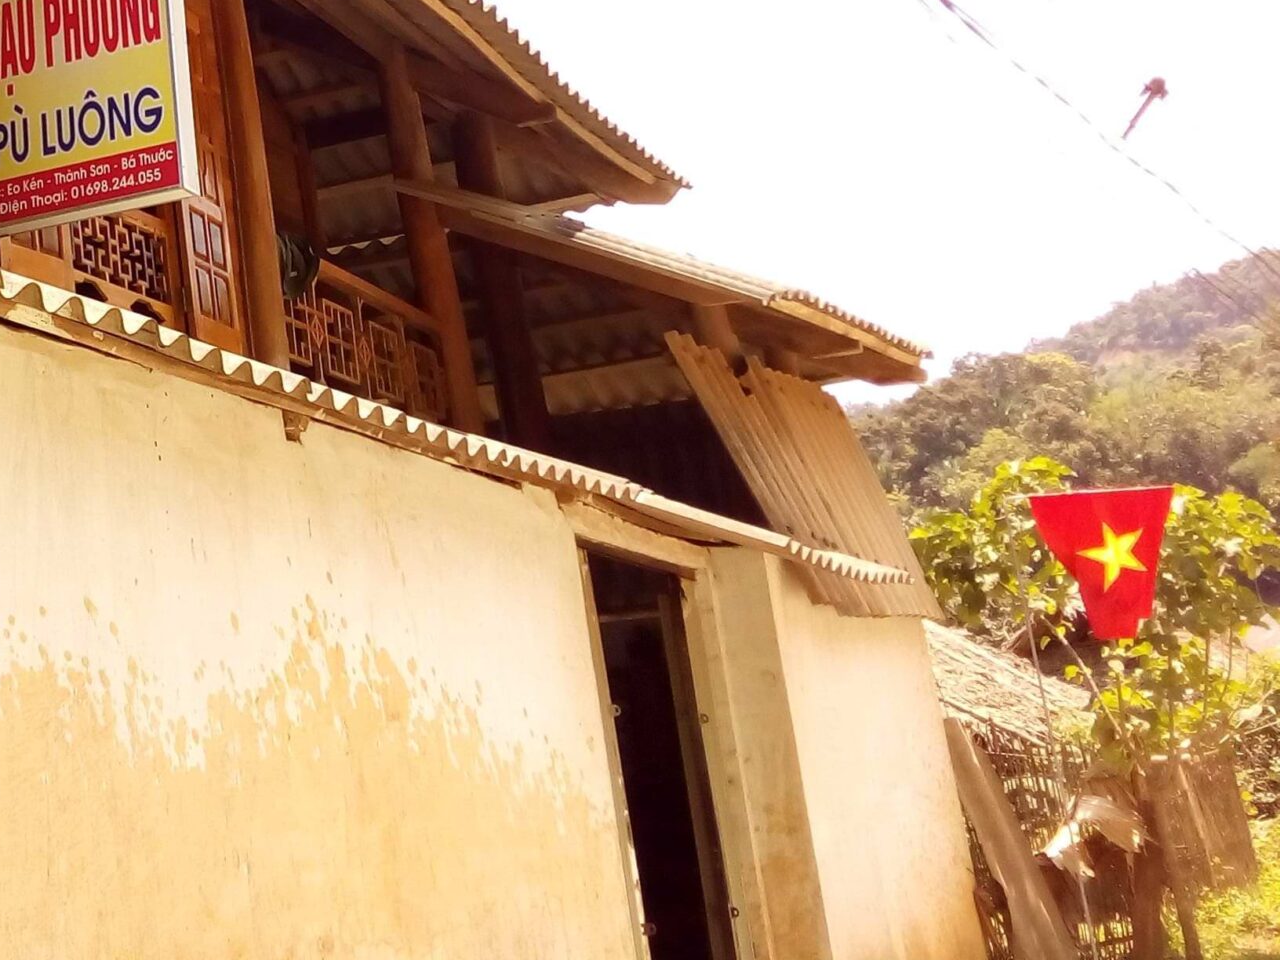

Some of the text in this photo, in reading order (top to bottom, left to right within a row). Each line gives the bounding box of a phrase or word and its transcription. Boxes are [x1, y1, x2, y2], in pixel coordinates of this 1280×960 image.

[41, 87, 163, 156] LUÔNG
[0, 168, 162, 215] Điện Thoại: 01698.244.055
[7, 183, 22, 196] Eo
[23, 177, 44, 192] Kén
[54, 167, 88, 186] Thành
[89, 162, 111, 177] Sơn
[121, 155, 136, 171] Bá
[138, 148, 174, 167] Thước
